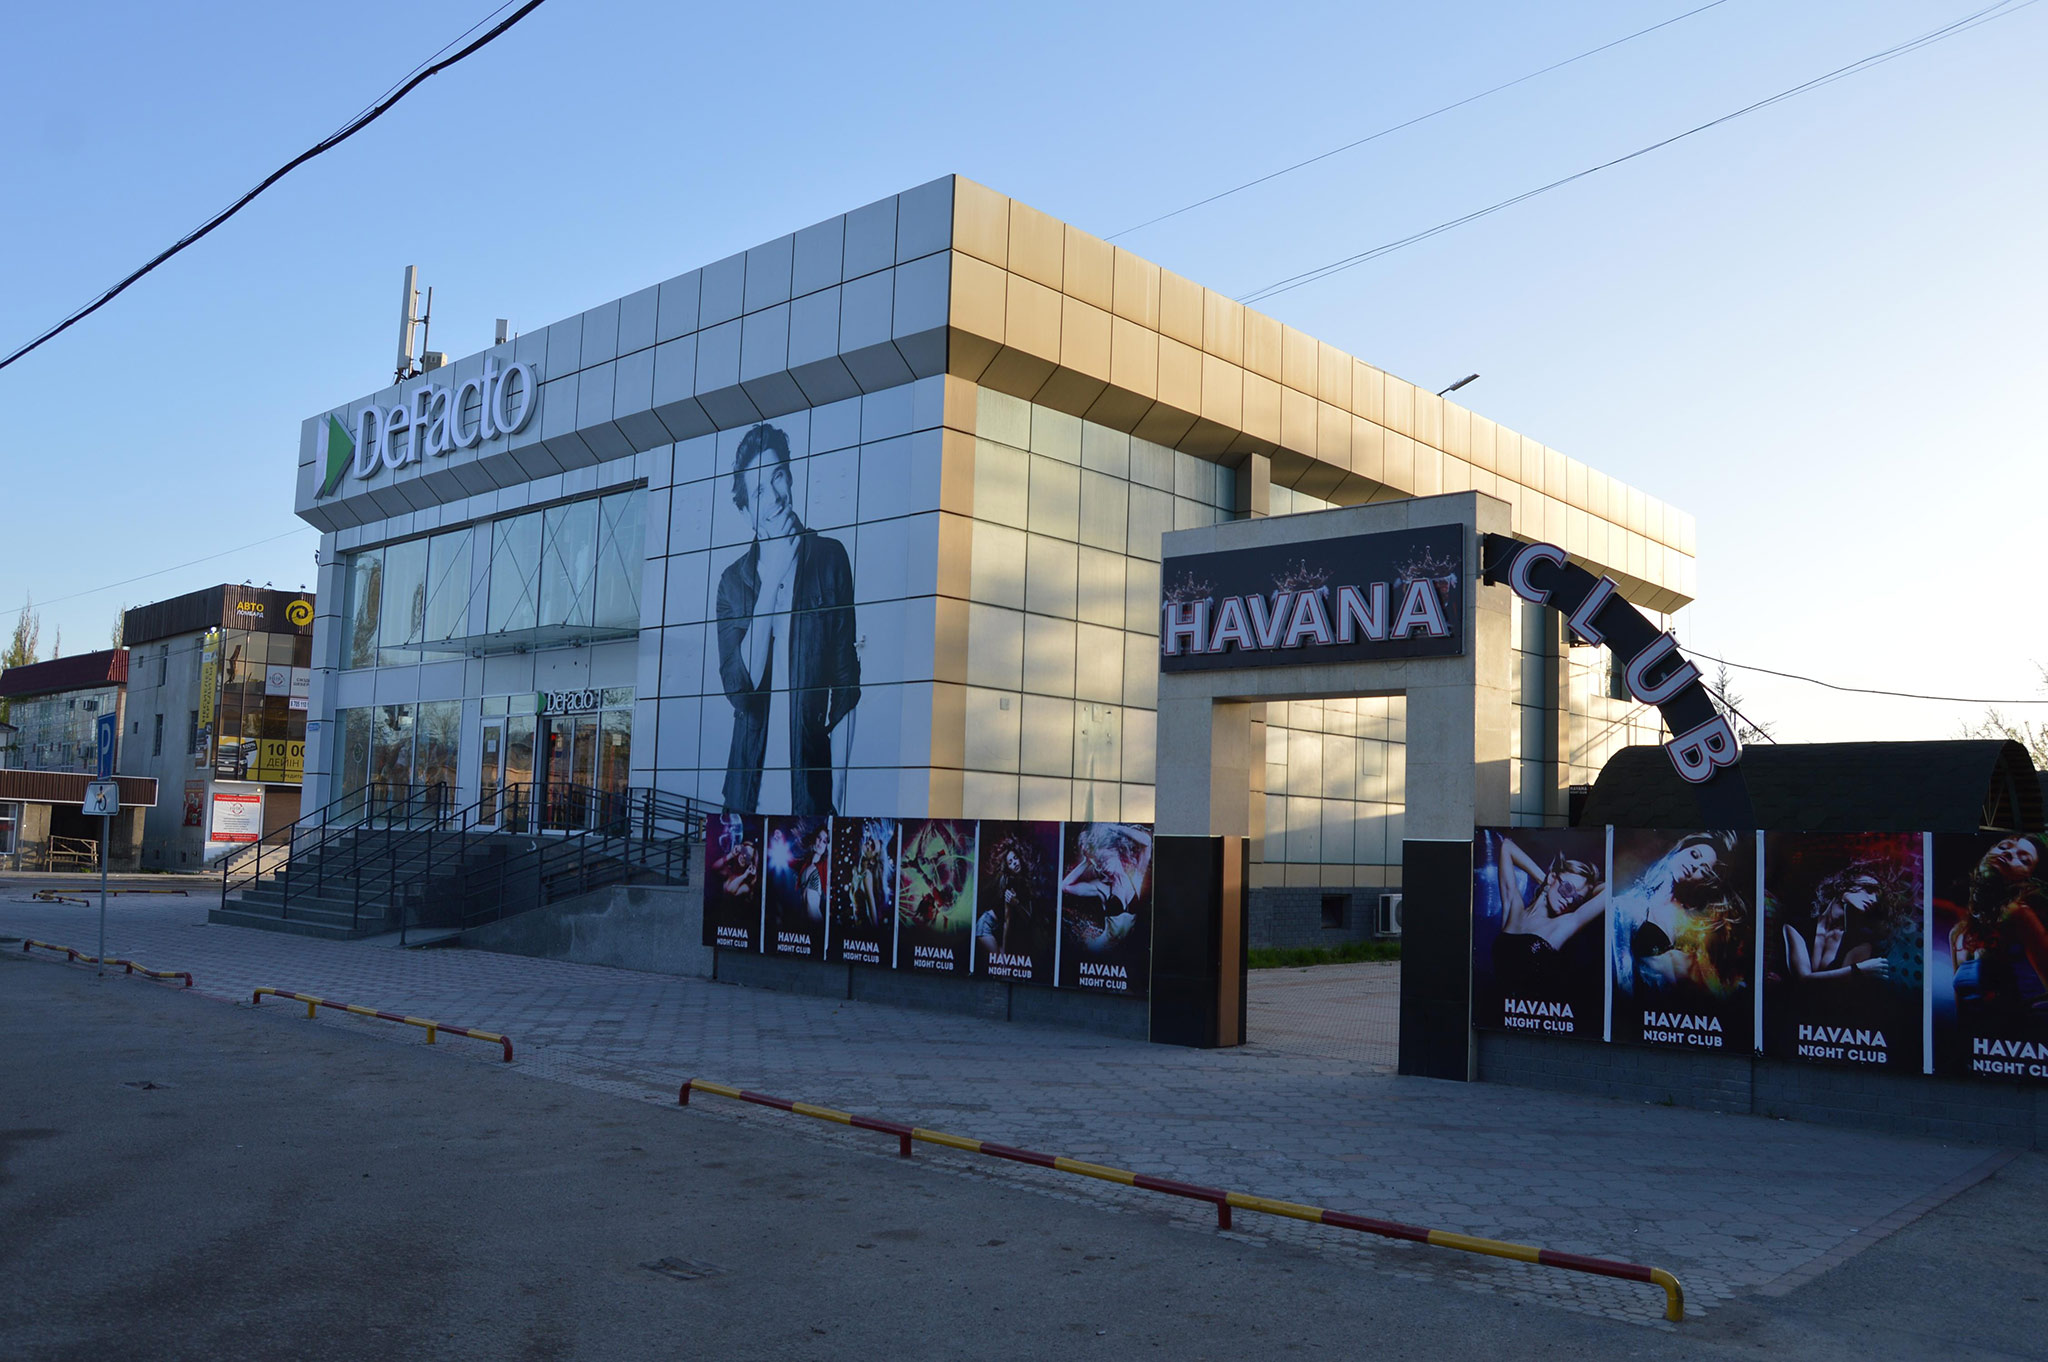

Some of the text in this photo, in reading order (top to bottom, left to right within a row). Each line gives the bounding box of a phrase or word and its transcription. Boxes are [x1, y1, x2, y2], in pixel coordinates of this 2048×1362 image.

[353, 356, 538, 480] DeFacto
[236, 601, 265, 612] АВТО
[1163, 577, 1450, 656] HAVANA
[1508, 541, 1743, 784] CLUB
[547, 691, 593, 711] DeFacto
[268, 743, 285, 756] 10
[717, 926, 748, 939] HAVANA
[778, 932, 812, 945] HAVANA
[716, 938, 748, 948] NIGHT CLUB
[777, 944, 811, 955] NIGHT CLUB
[843, 938, 880, 953] HAVANA
[842, 952, 880, 964] NIGHT CLUB
[914, 946, 954, 960] HAVANA
[988, 952, 1032, 968] HAVANA
[914, 959, 954, 971] NIGHT CLUB
[988, 966, 1032, 979] NIGHT CLUB
[1080, 962, 1128, 979] HAVANA
[1079, 978, 1127, 990] NIGHT CLUB
[1504, 998, 1574, 1018] HAVANA
[1504, 1016, 1574, 1032] NIGHT CLUB
[1643, 1010, 1723, 1033] HAVANA
[1643, 1030, 1723, 1048] NIGHT CLUB
[1798, 1024, 1888, 1048] HAVANA
[1798, 1044, 1888, 1064] NIGHT CLUB
[1972, 1059, 2025, 1076] NIGHT
